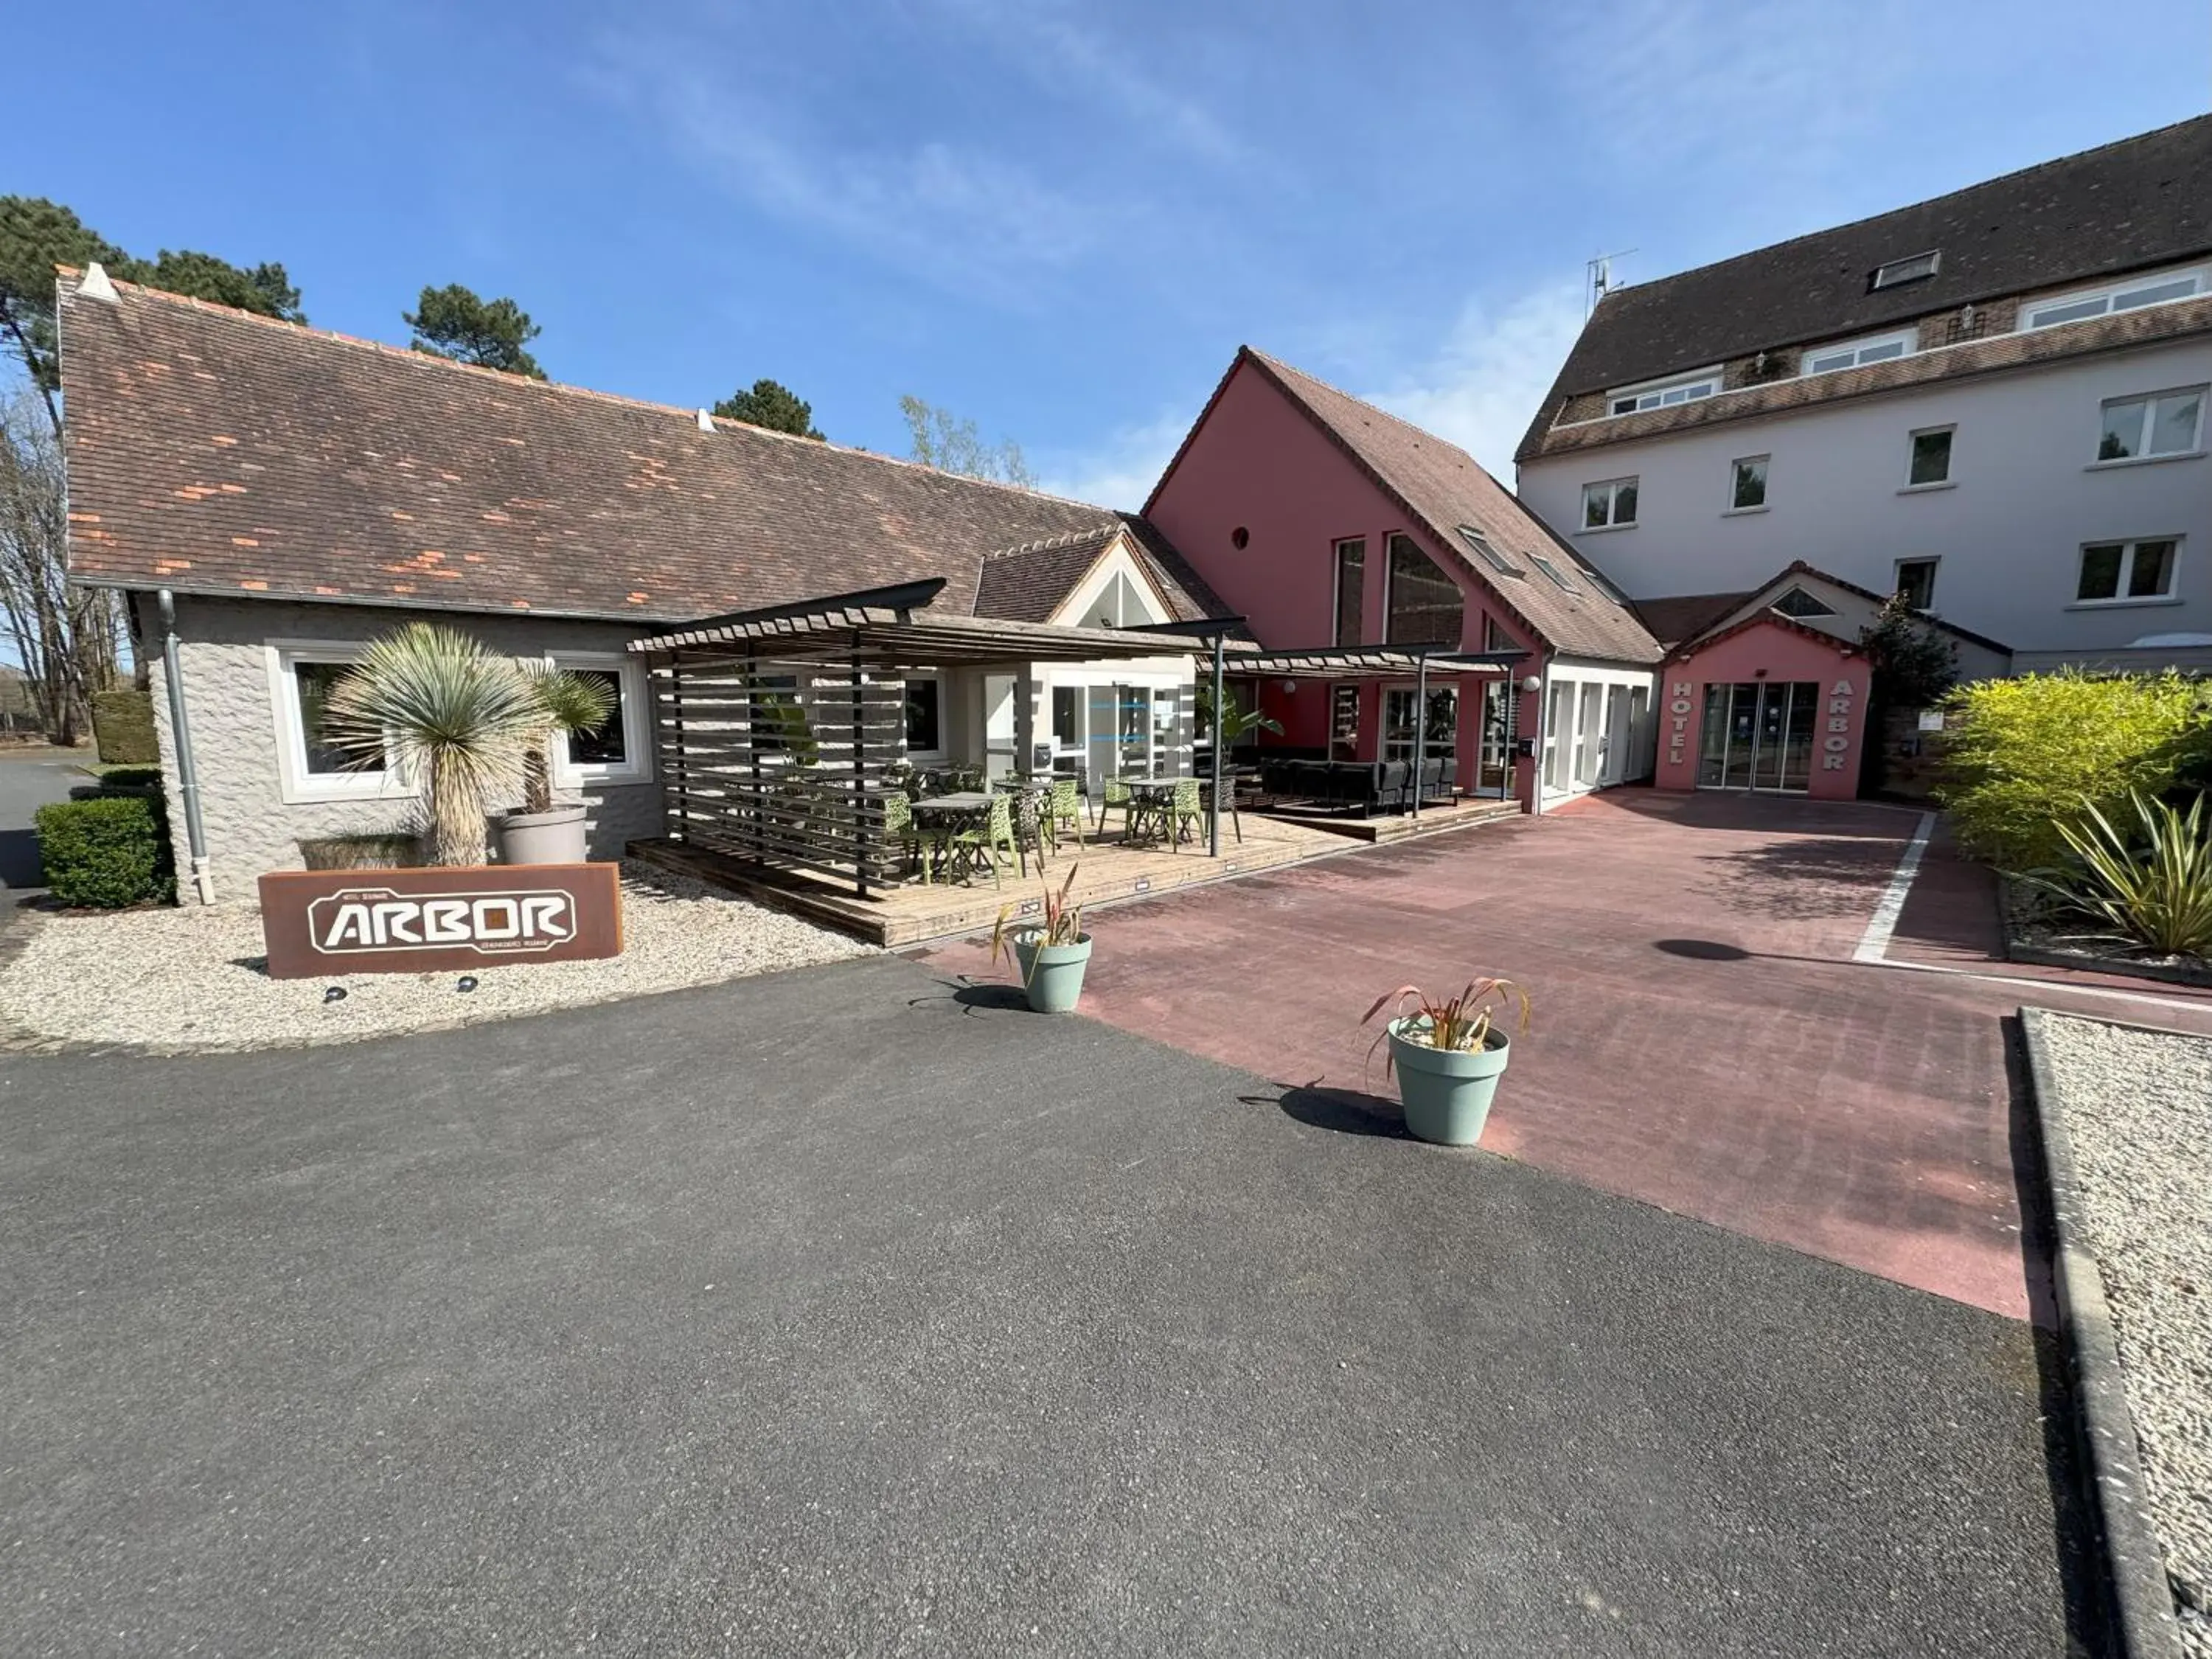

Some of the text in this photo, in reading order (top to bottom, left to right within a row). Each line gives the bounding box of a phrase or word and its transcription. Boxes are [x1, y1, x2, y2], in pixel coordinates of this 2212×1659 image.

[1669, 682, 1692, 764] HOTEL
[1823, 680, 1854, 770] ARBOR
[324, 897, 567, 947] ARBOR
